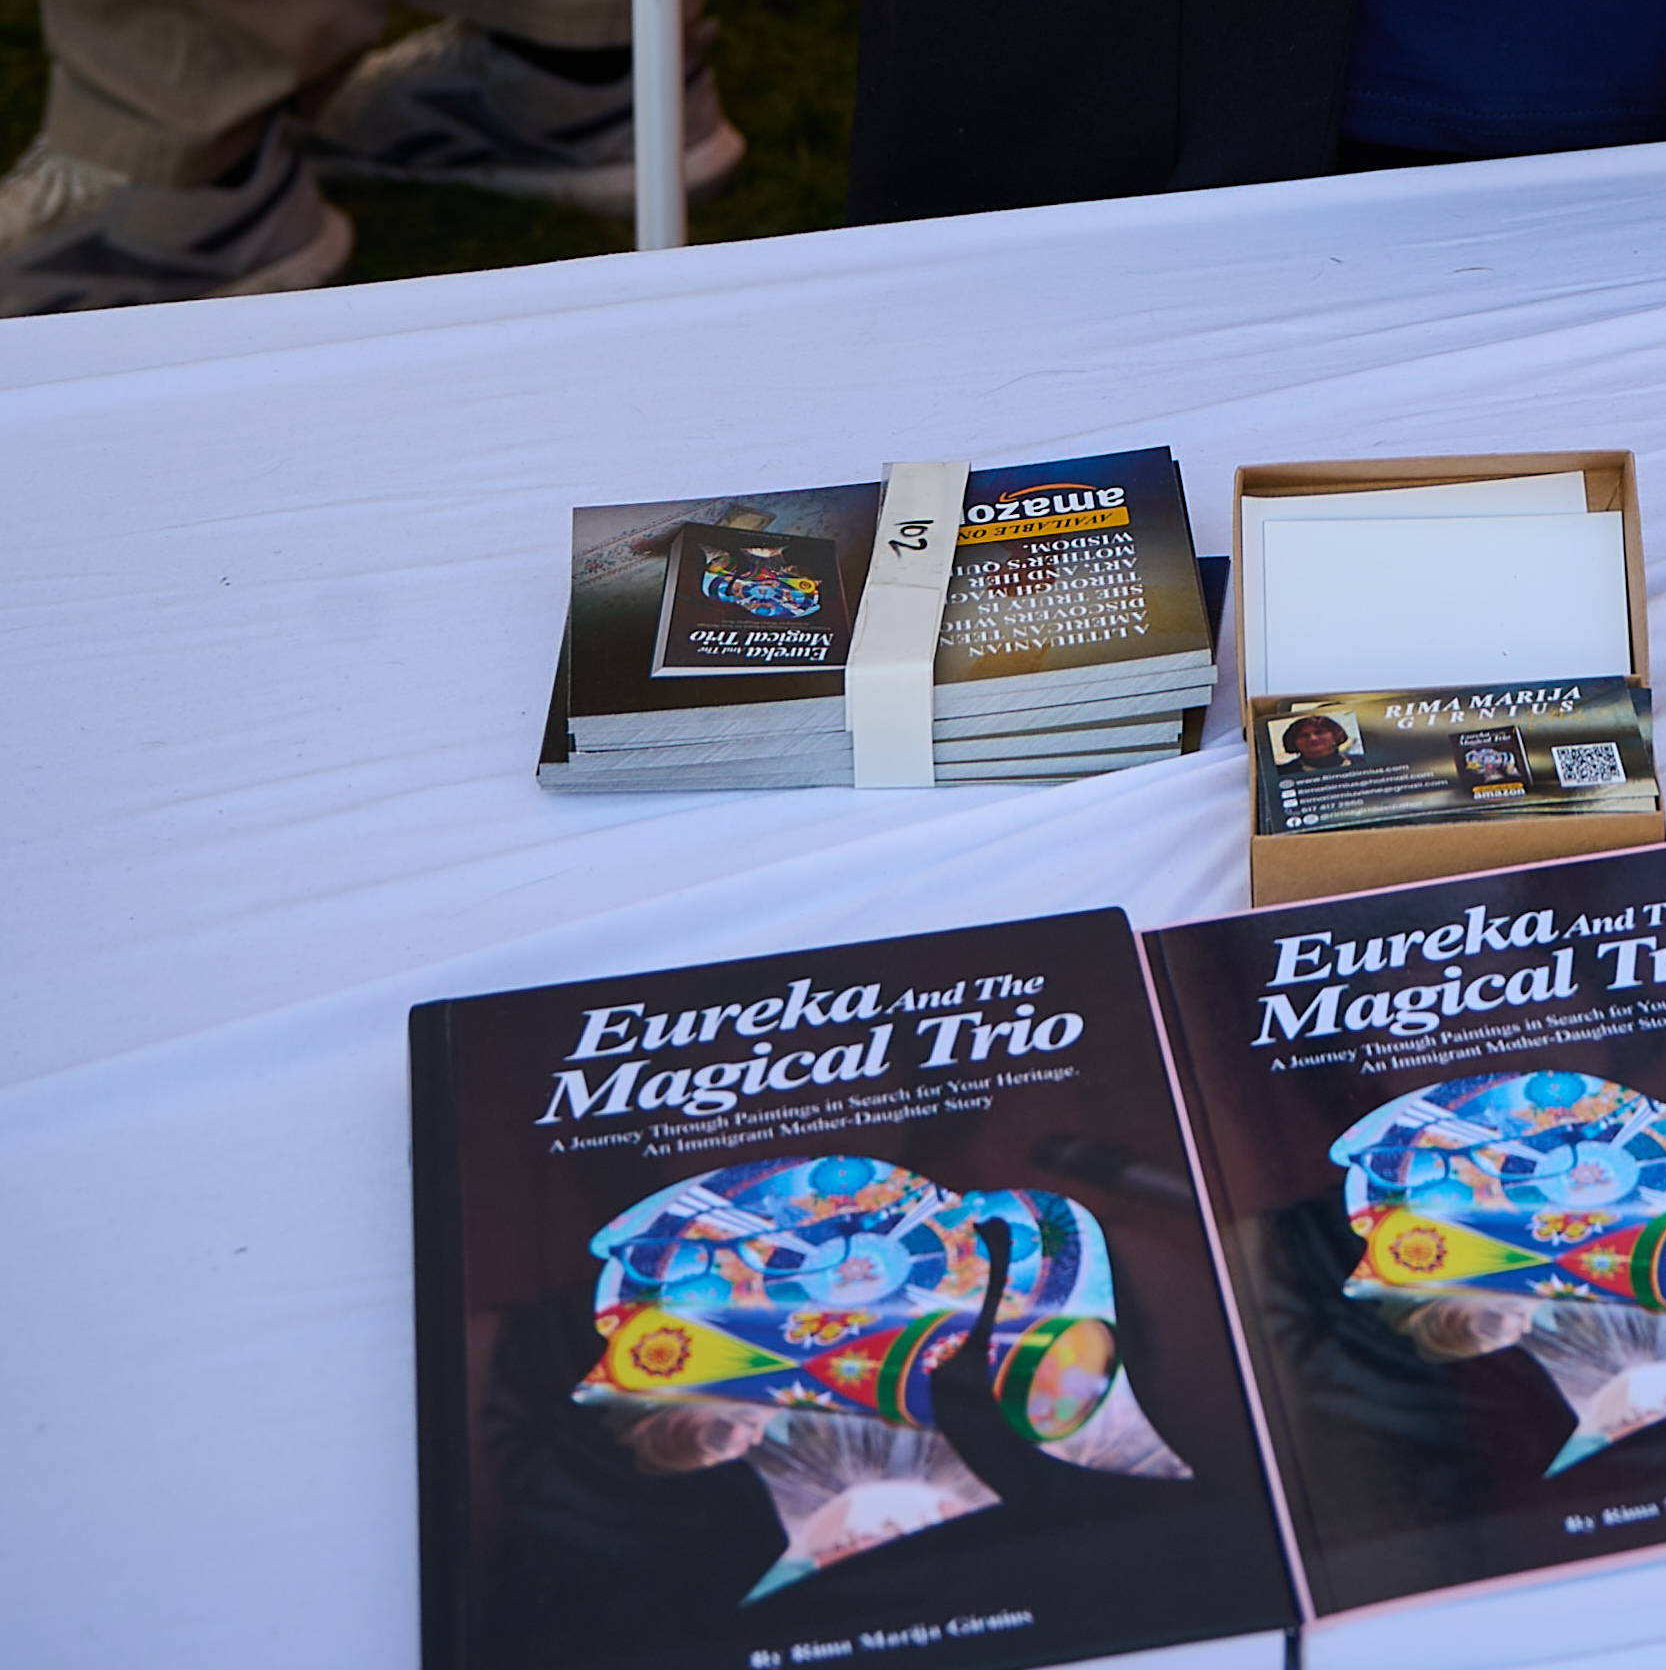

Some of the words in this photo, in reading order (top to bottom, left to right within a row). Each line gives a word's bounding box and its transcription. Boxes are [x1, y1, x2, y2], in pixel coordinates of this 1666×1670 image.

[964, 486, 1126, 525] amazo
[957, 527, 988, 542] ON
[993, 510, 1113, 537] AVAILABLE
[1023, 531, 1134, 555] WISDOM.
[956, 561, 1001, 578] QUI
[1008, 544, 1135, 572] MOTHER'S
[970, 574, 1020, 589] HER
[1017, 571, 1142, 598] THROUGH
[1028, 567, 1077, 583] AND
[950, 587, 1009, 604] MAG
[1010, 590, 1090, 611] TRULY
[1098, 583, 1144, 595] SHE
[978, 602, 1000, 615] IS
[1004, 598, 1146, 626] DISCOVERS
[689, 629, 740, 646] Trio
[940, 628, 1001, 647] TEEN
[1012, 610, 1148, 638] AMERICAN
[1134, 623, 1149, 636] A
[744, 629, 836, 647] Magical
[969, 625, 1127, 658] LITHUANIAN
[745, 645, 829, 662] Eureka
[1384, 696, 1463, 719] RIMA
[1469, 685, 1582, 709] MARIJA
[1397, 699, 1576, 730] GIRNIUS
[1266, 904, 1559, 987] Eureka
[1563, 906, 1635, 939] And
[1250, 947, 1578, 1047] Magical
[564, 977, 883, 1061] Eureka
[884, 981, 966, 1014] And
[974, 973, 1044, 1001] The
[533, 1022, 894, 1125] Magical
[916, 1004, 1084, 1069] Trio
[550, 1138, 565, 1154] A
[569, 1129, 643, 1151] Journey
[649, 1115, 729, 1140] Through
[734, 1103, 820, 1128] Paintings
[826, 1097, 843, 1112] in
[848, 1087, 911, 1109] Search
[916, 1082, 943, 1099] for
[947, 1077, 992, 1094] Your
[997, 1065, 1080, 1087] Heritage.
[643, 1141, 671, 1158] An
[676, 1128, 774, 1153] Immigrant
[779, 1101, 940, 1137] Mother-Daughter
[944, 1094, 994, 1111] Story
